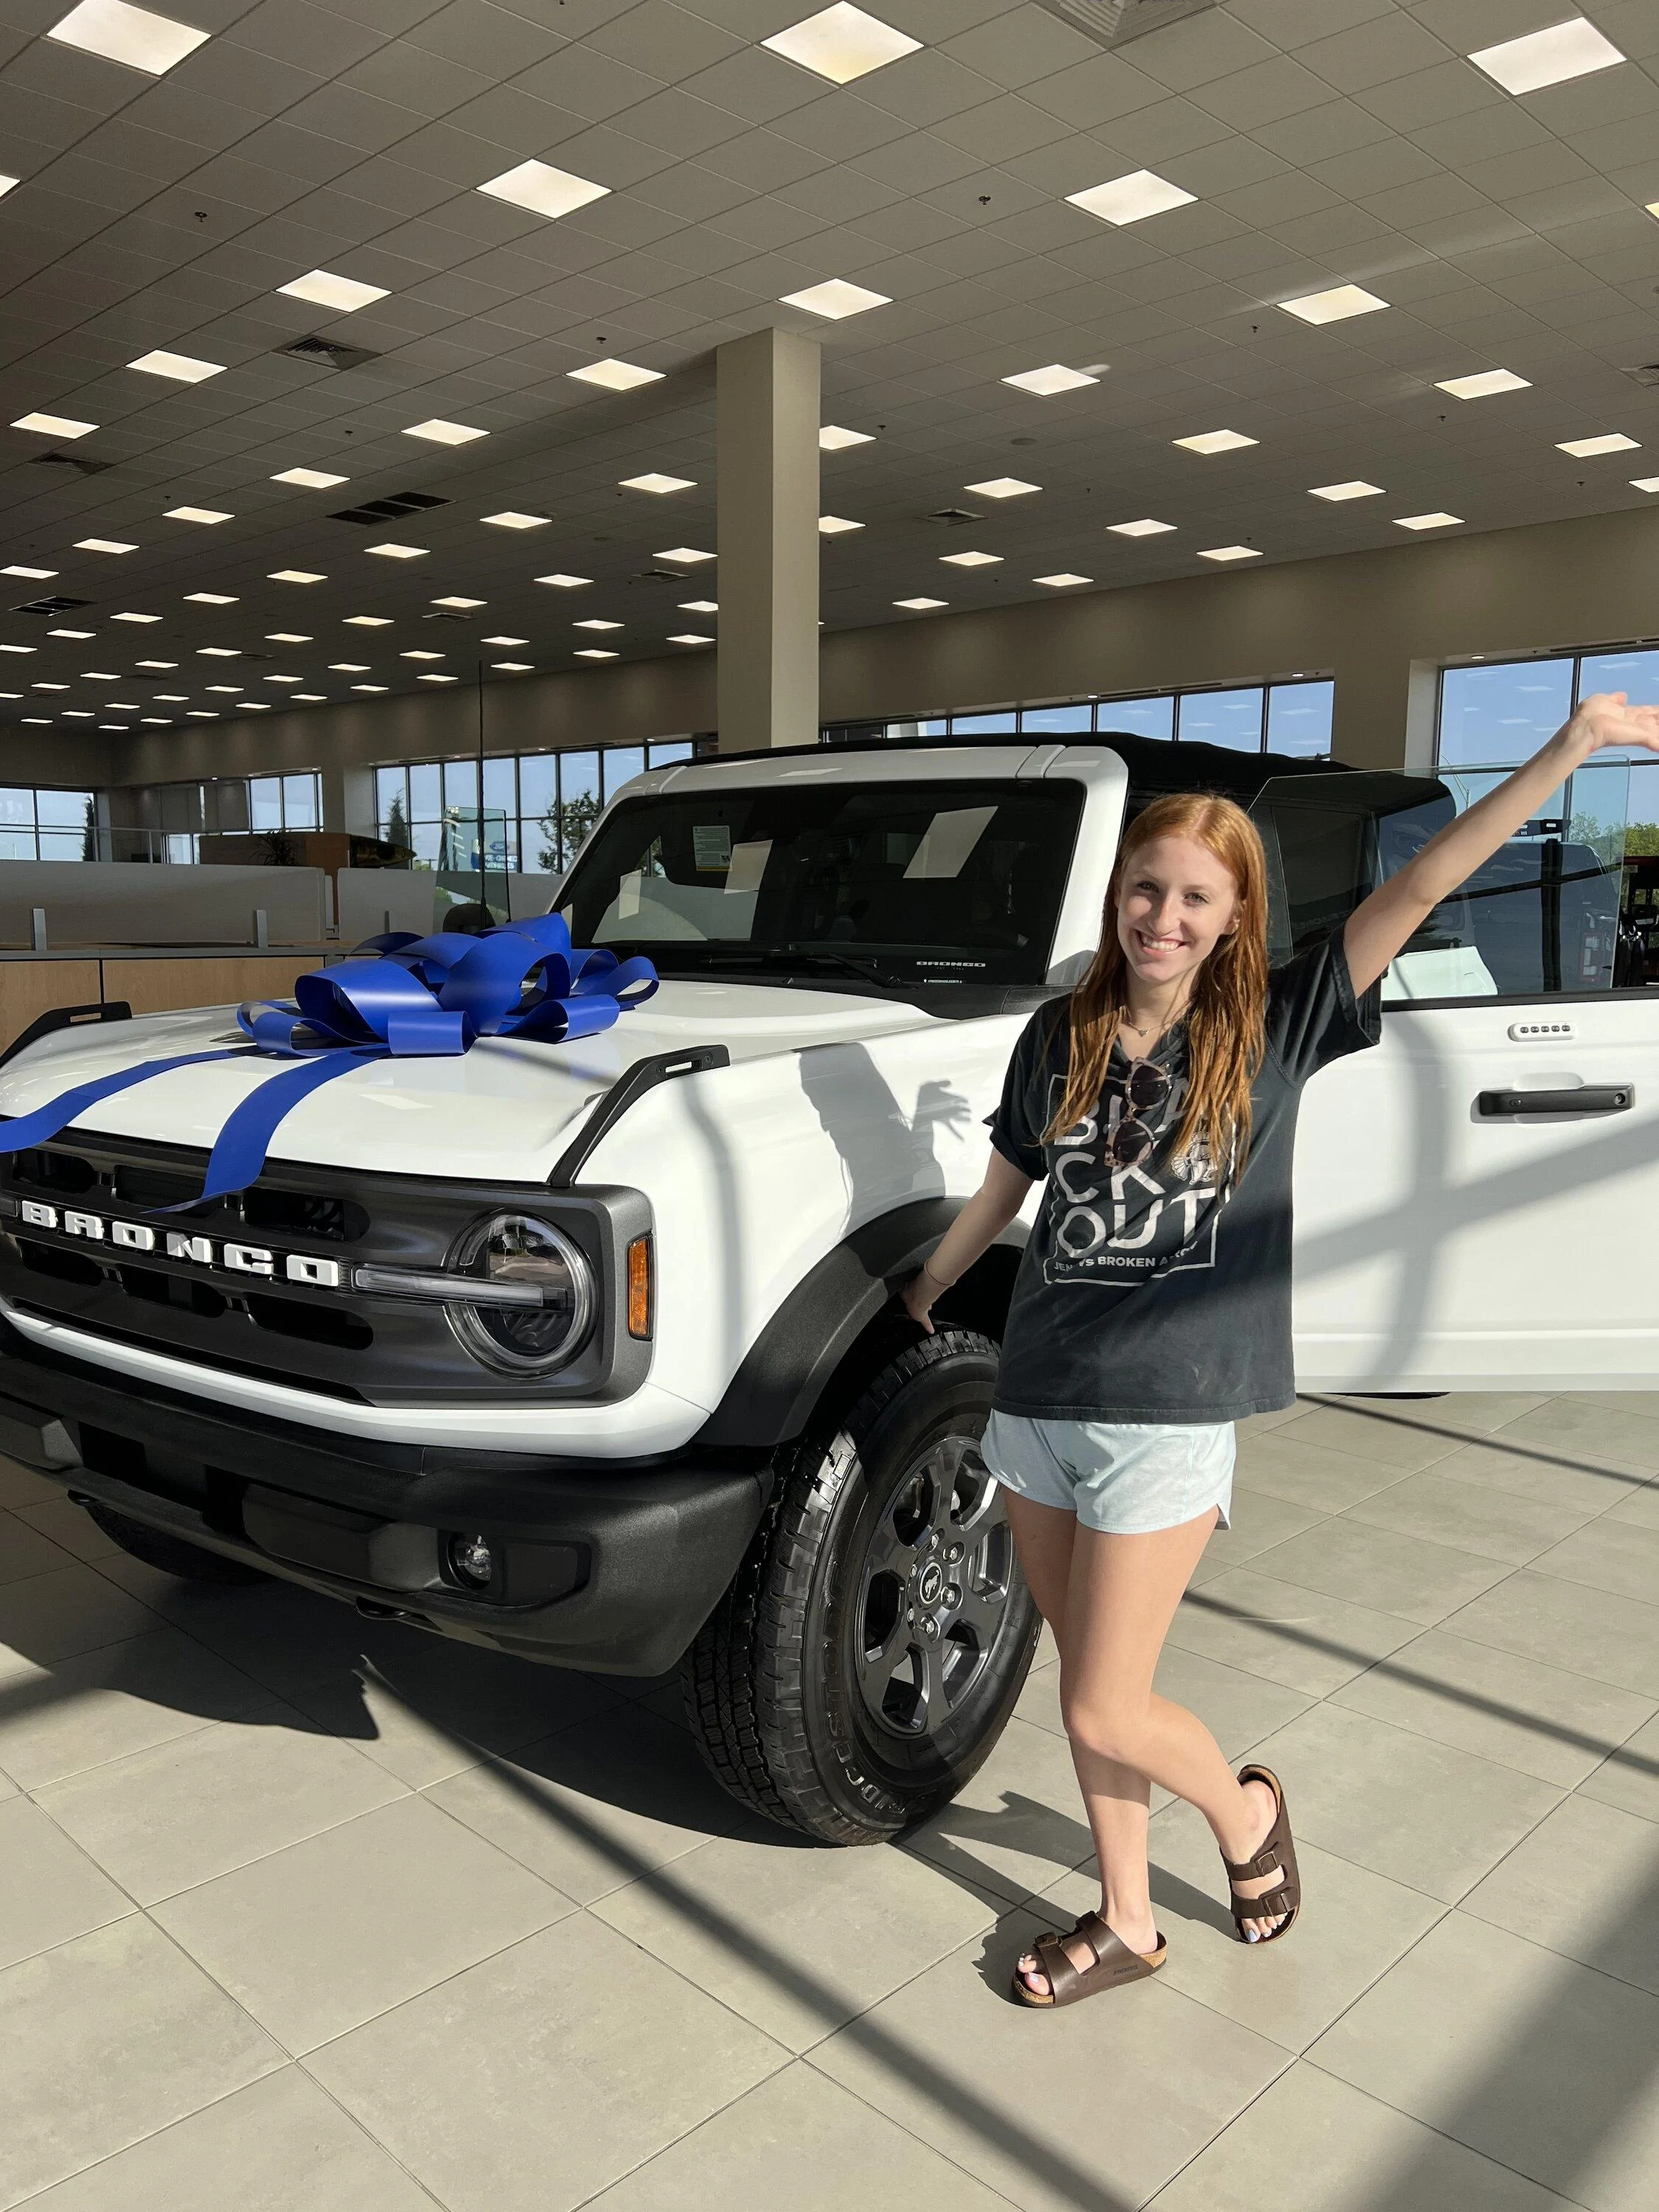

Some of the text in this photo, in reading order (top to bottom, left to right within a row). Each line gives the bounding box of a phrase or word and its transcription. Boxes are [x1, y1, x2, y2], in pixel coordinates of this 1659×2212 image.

[21, 1200, 339, 1287] BRONCO
[1057, 1186, 1216, 1259] OUT
[1097, 1256, 1156, 1267] BROKEN
[821, 1558, 935, 1815] RIDGESTONE
